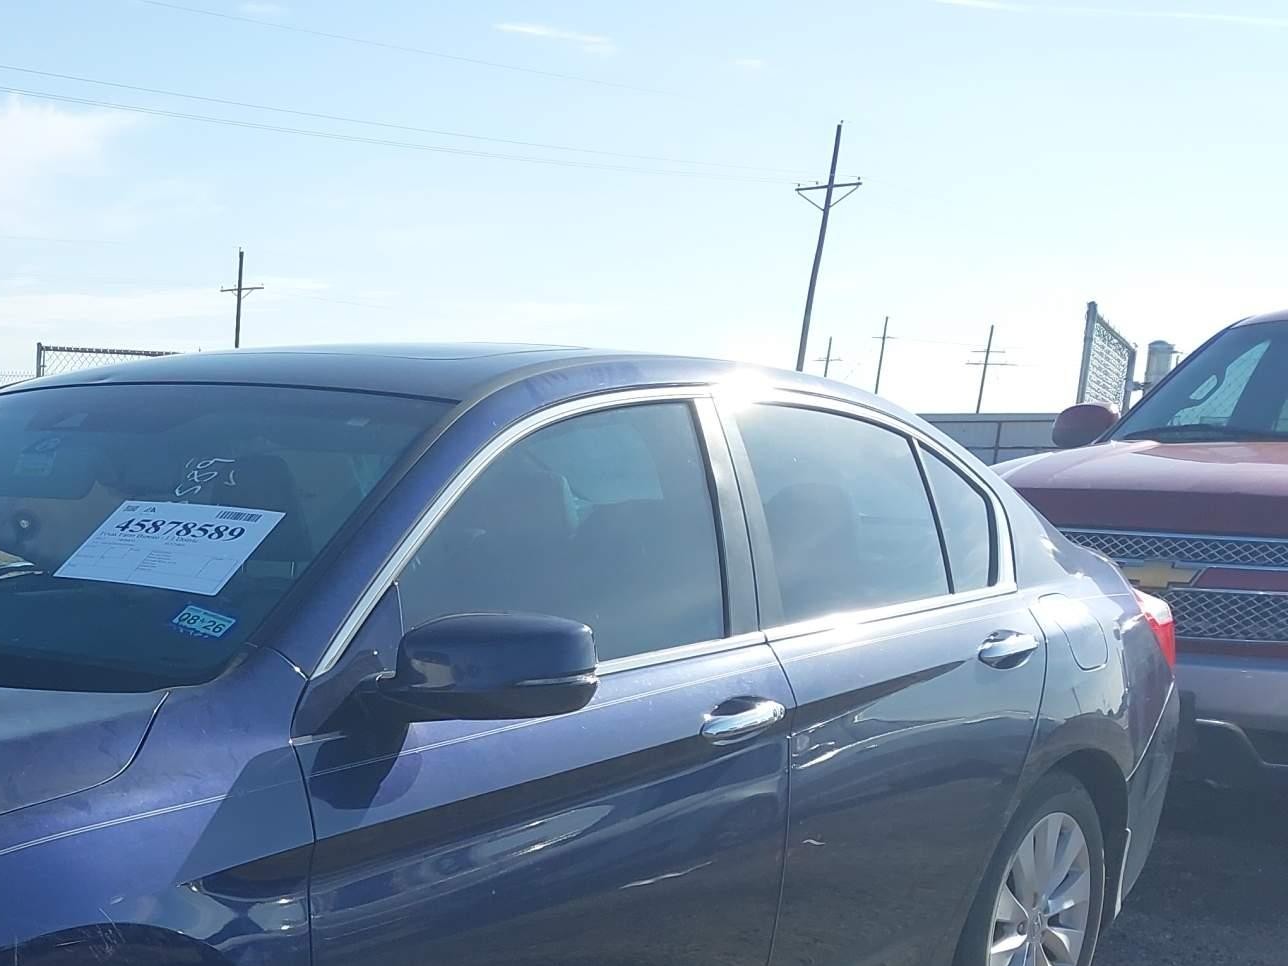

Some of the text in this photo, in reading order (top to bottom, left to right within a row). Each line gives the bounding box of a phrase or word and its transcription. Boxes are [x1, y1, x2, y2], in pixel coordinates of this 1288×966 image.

[115, 518, 246, 542] 45878589
[178, 612, 226, 633] 08 26
